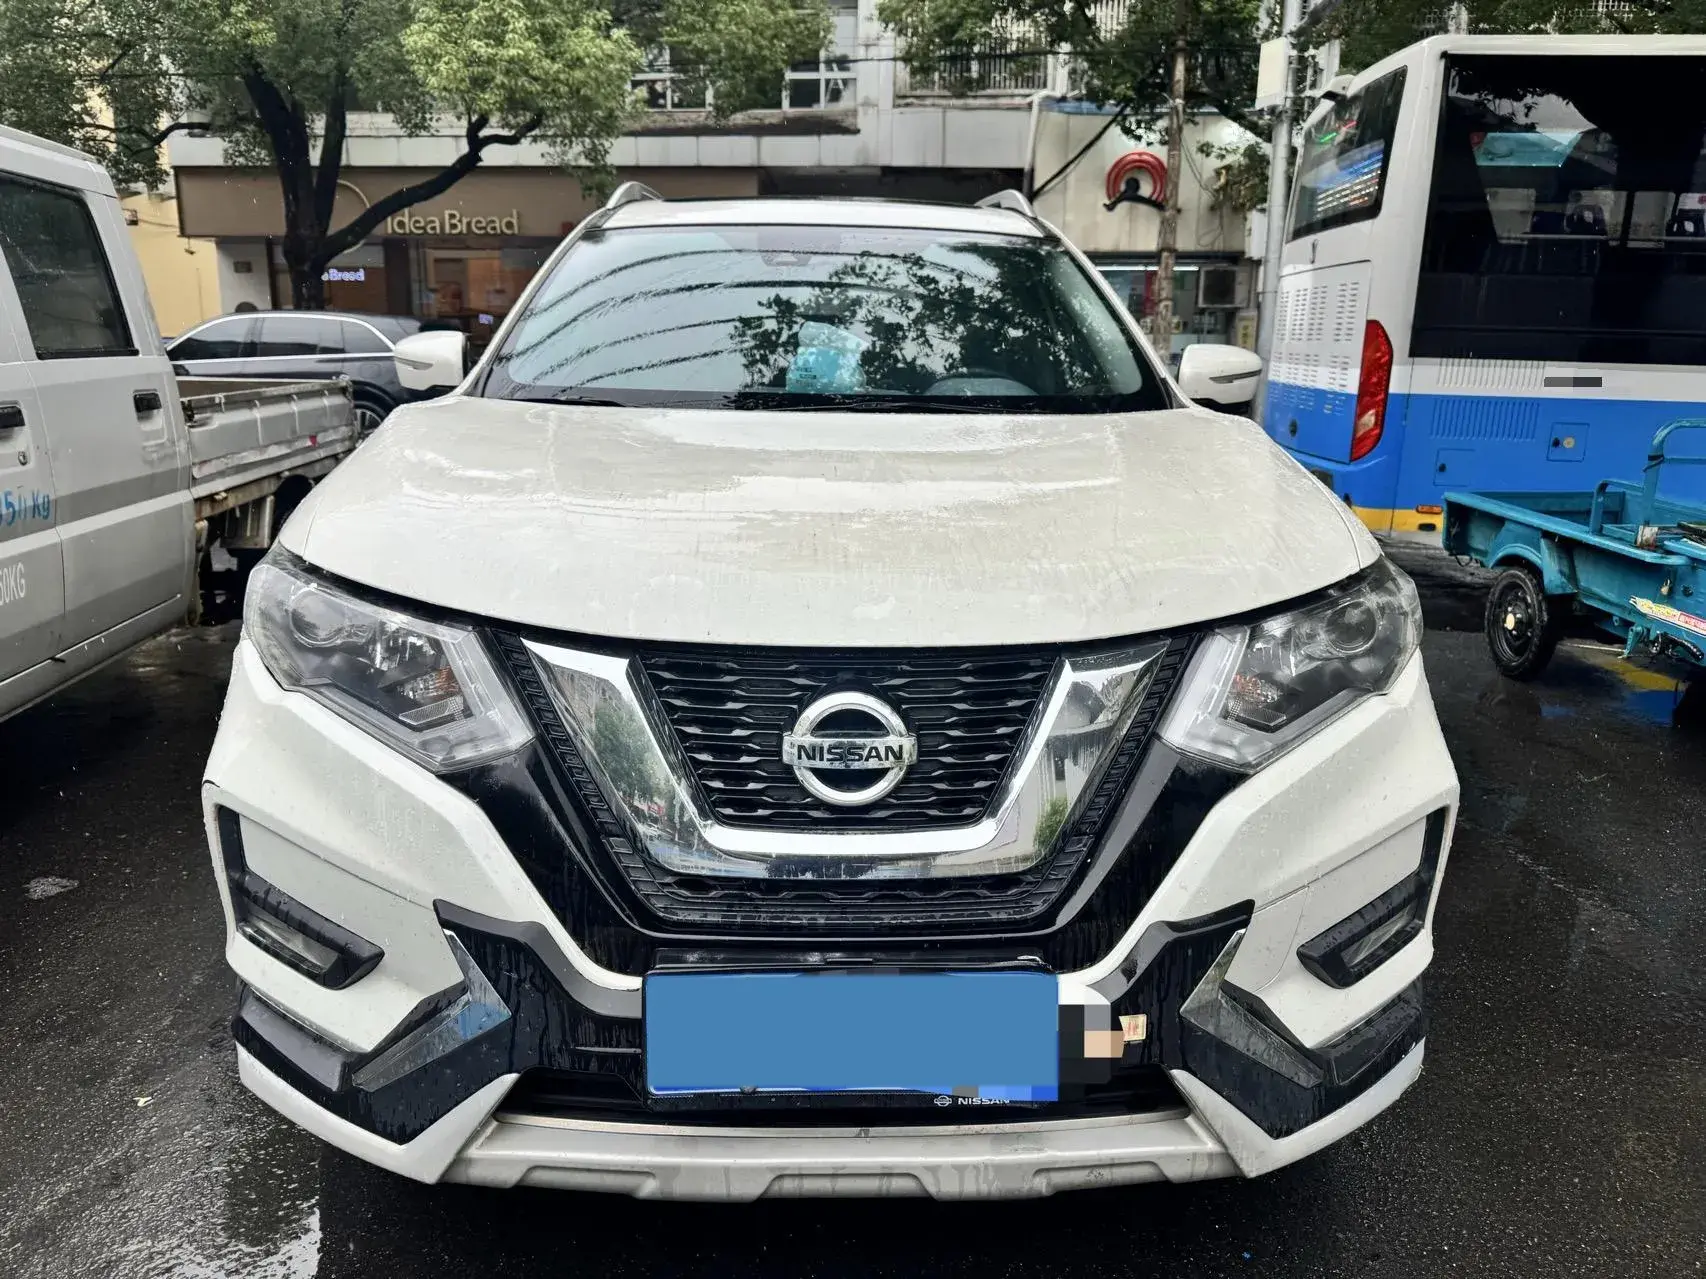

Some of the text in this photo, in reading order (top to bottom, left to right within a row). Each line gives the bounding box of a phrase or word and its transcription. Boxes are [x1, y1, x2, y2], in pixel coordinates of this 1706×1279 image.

[386, 208, 519, 234] Idea Bread
[797, 744, 904, 762] NISSAN
